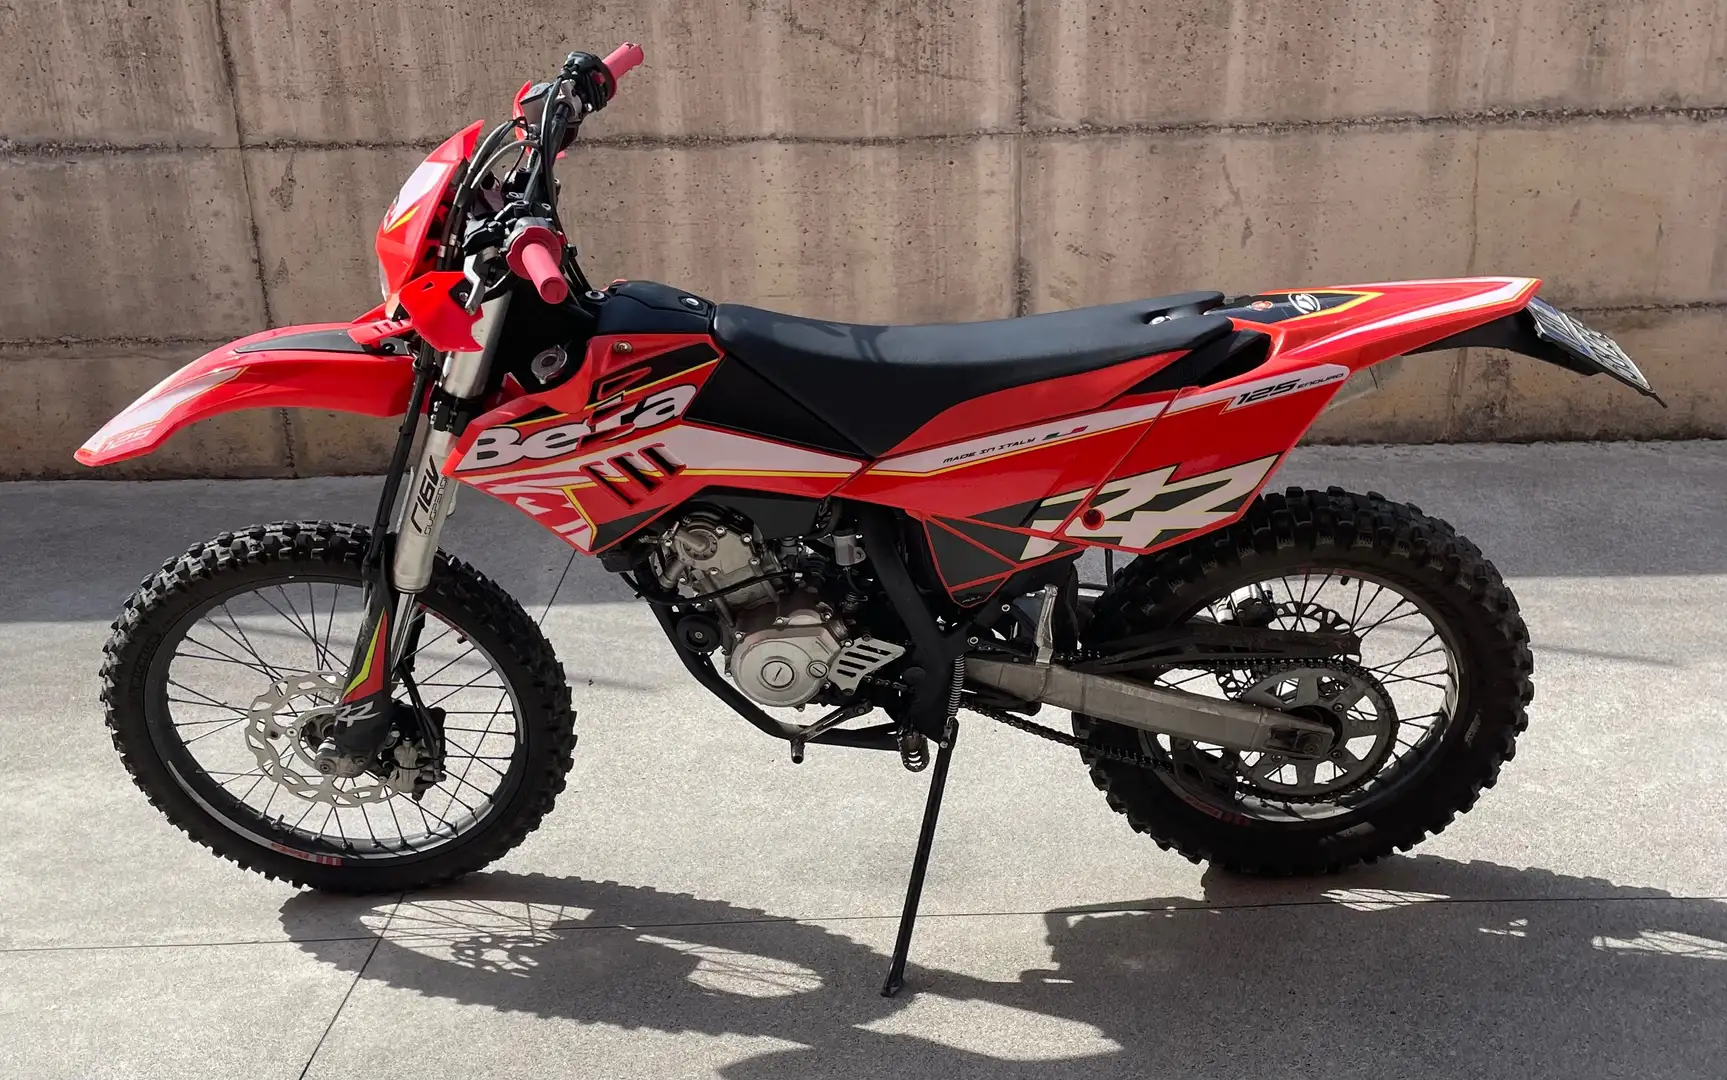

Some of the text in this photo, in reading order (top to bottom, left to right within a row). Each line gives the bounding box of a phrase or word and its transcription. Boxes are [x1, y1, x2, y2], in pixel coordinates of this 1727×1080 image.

[1237, 373, 1344, 405] 125 ENDURO
[454, 384, 697, 472] Beta
[942, 451, 977, 464] MADE
[998, 436, 1036, 451] ITALY
